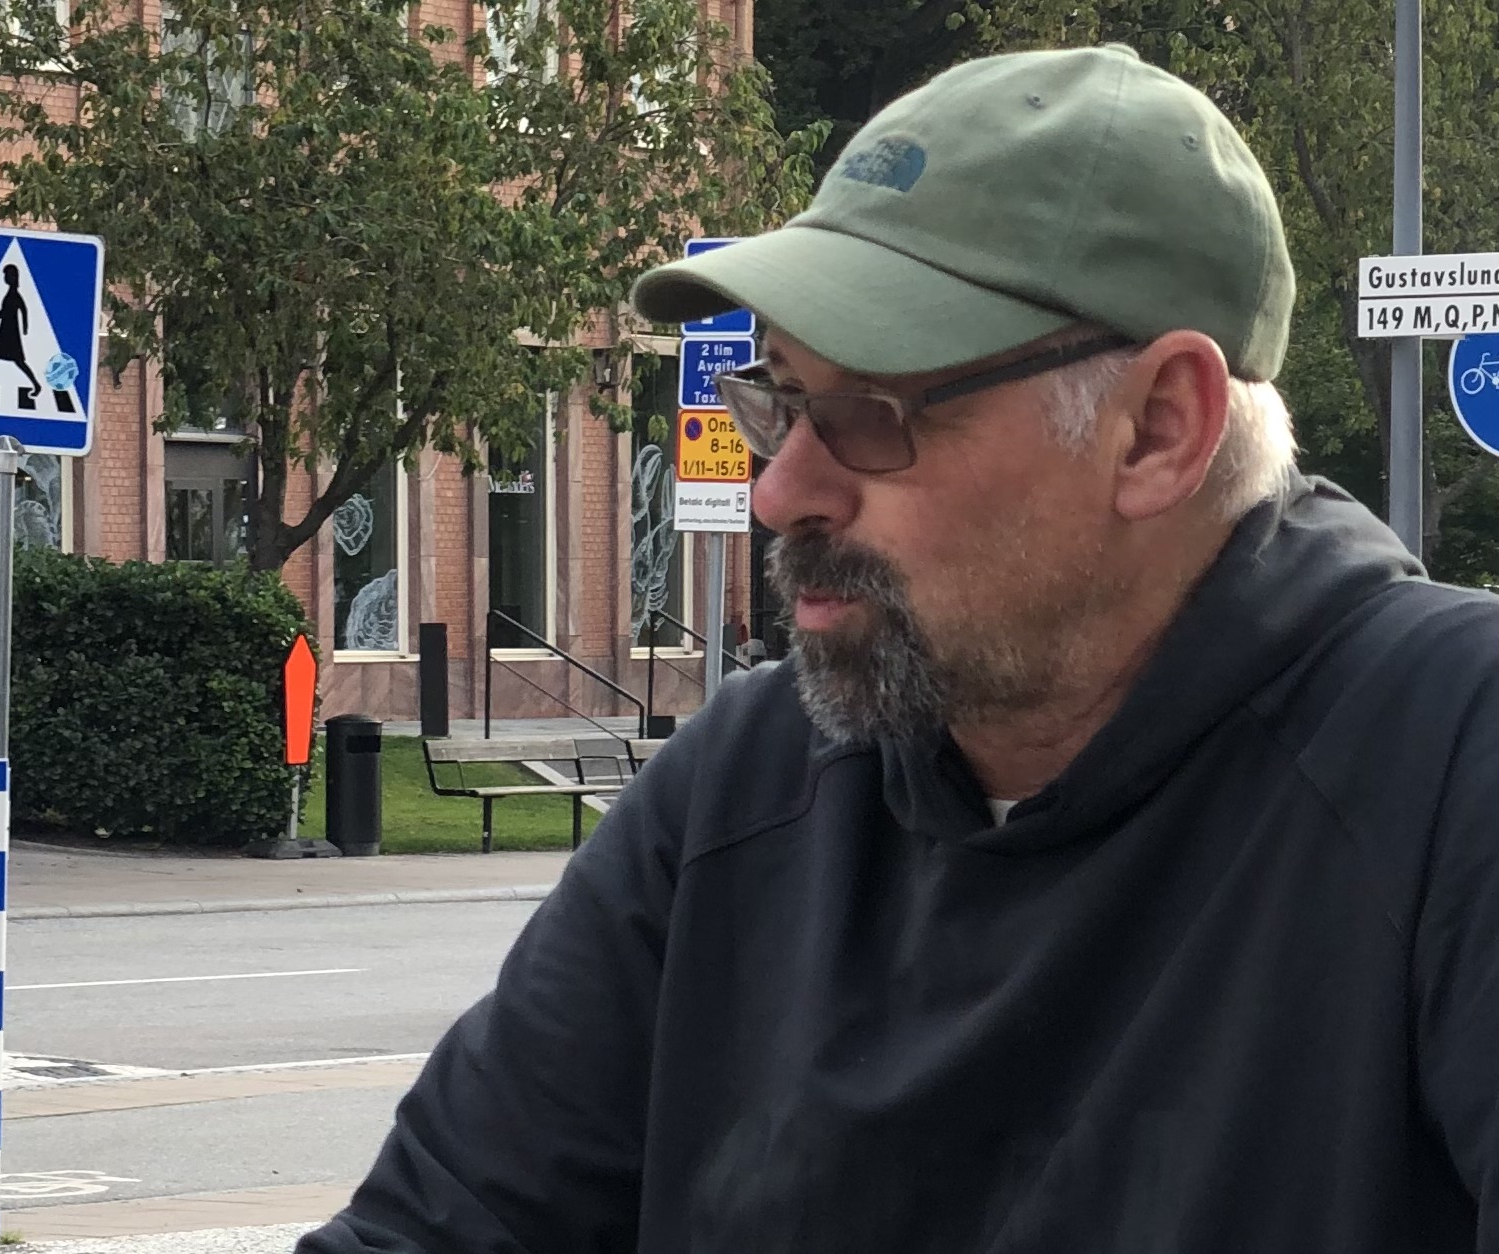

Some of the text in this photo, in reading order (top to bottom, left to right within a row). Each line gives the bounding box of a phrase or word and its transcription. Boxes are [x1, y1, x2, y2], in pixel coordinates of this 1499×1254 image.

[1368, 306, 1404, 330] 149
[701, 343, 734, 356] 2 tim
[697, 359, 737, 374] Avgift
[707, 417, 737, 433] Ons
[710, 438, 744, 453] 8-16
[683, 460, 746, 477] 1/11-15/5
